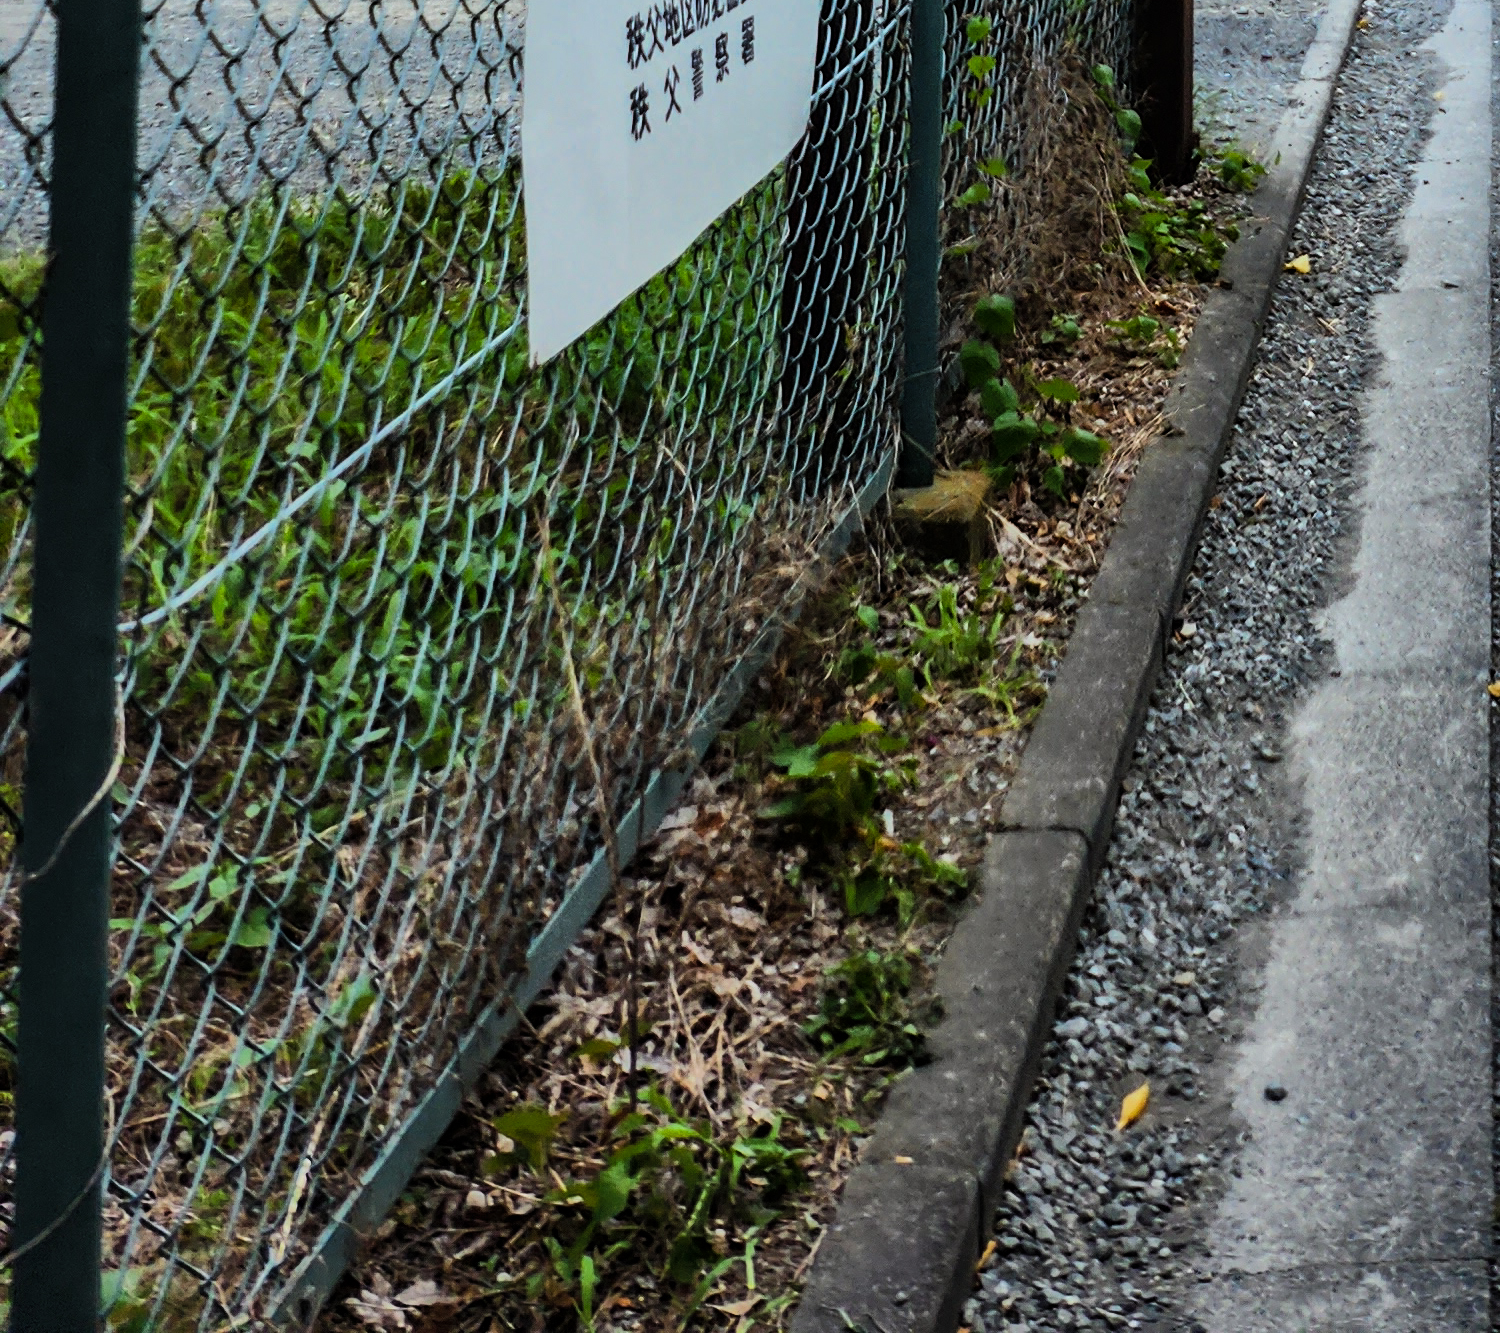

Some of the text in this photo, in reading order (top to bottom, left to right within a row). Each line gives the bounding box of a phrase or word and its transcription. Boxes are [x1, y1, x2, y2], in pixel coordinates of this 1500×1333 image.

[629, 15, 755, 142] 秩父警察署
